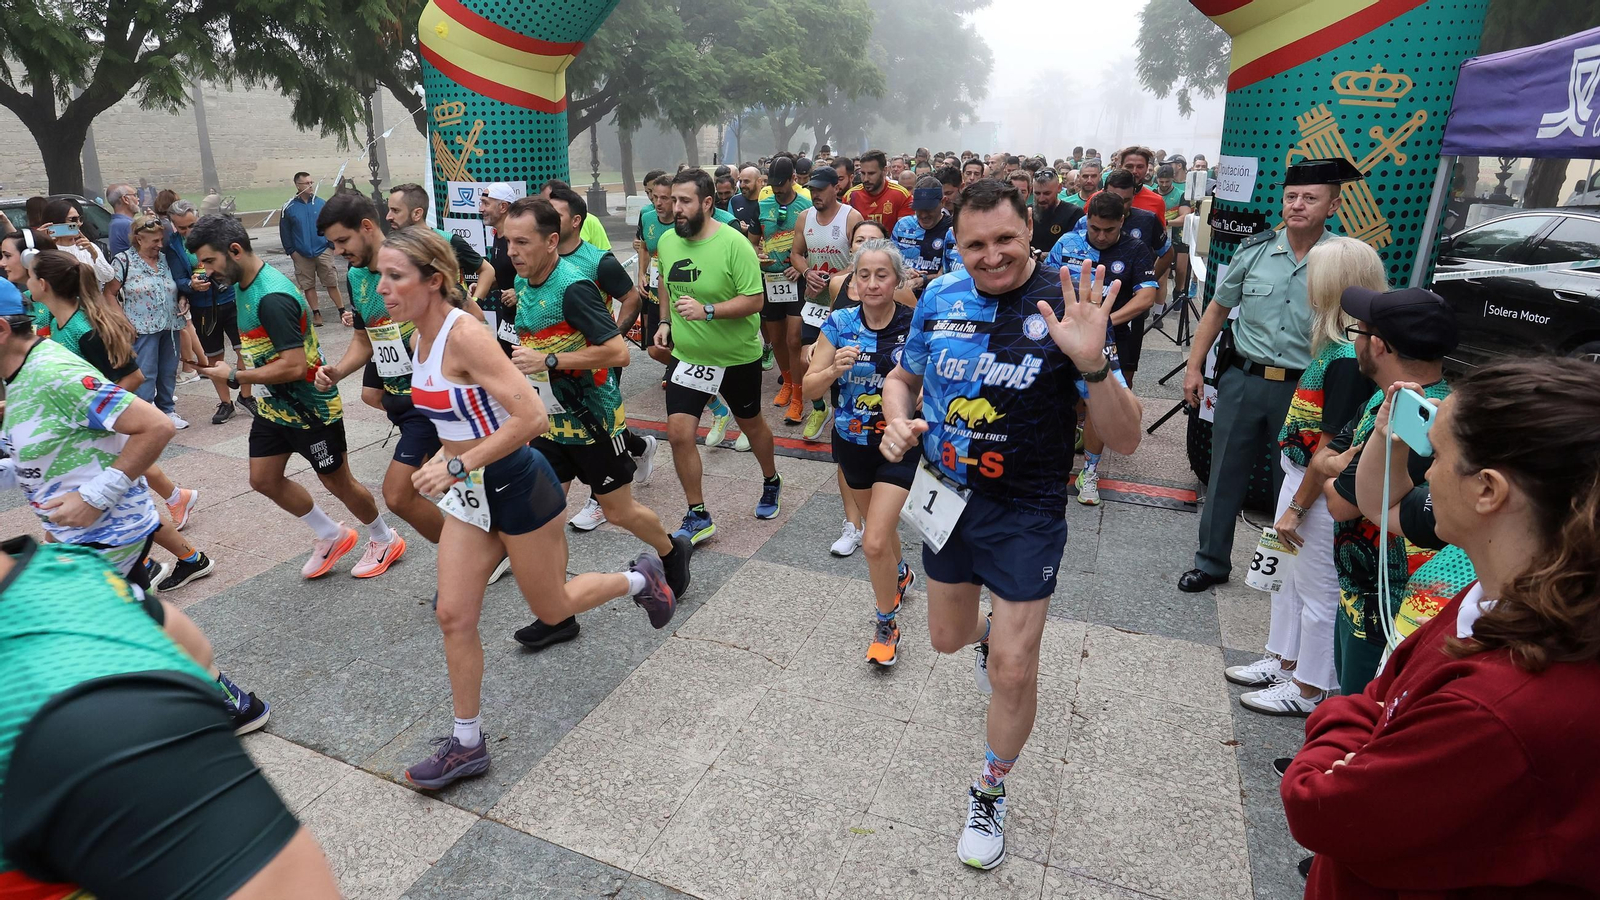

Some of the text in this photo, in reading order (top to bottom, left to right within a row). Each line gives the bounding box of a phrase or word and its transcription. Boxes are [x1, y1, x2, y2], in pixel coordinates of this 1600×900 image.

[1222, 180, 1240, 193] Cádiz
[673, 284, 695, 294] MILLA
[772, 284, 792, 295] 131
[807, 306, 831, 321] 145
[1488, 304, 1551, 325] Solera Motor
[378, 345, 400, 363] 300
[684, 364, 716, 381] 285
[318, 454, 335, 469] NIKE
[923, 489, 938, 515] 1
[1250, 551, 1279, 576] 83
